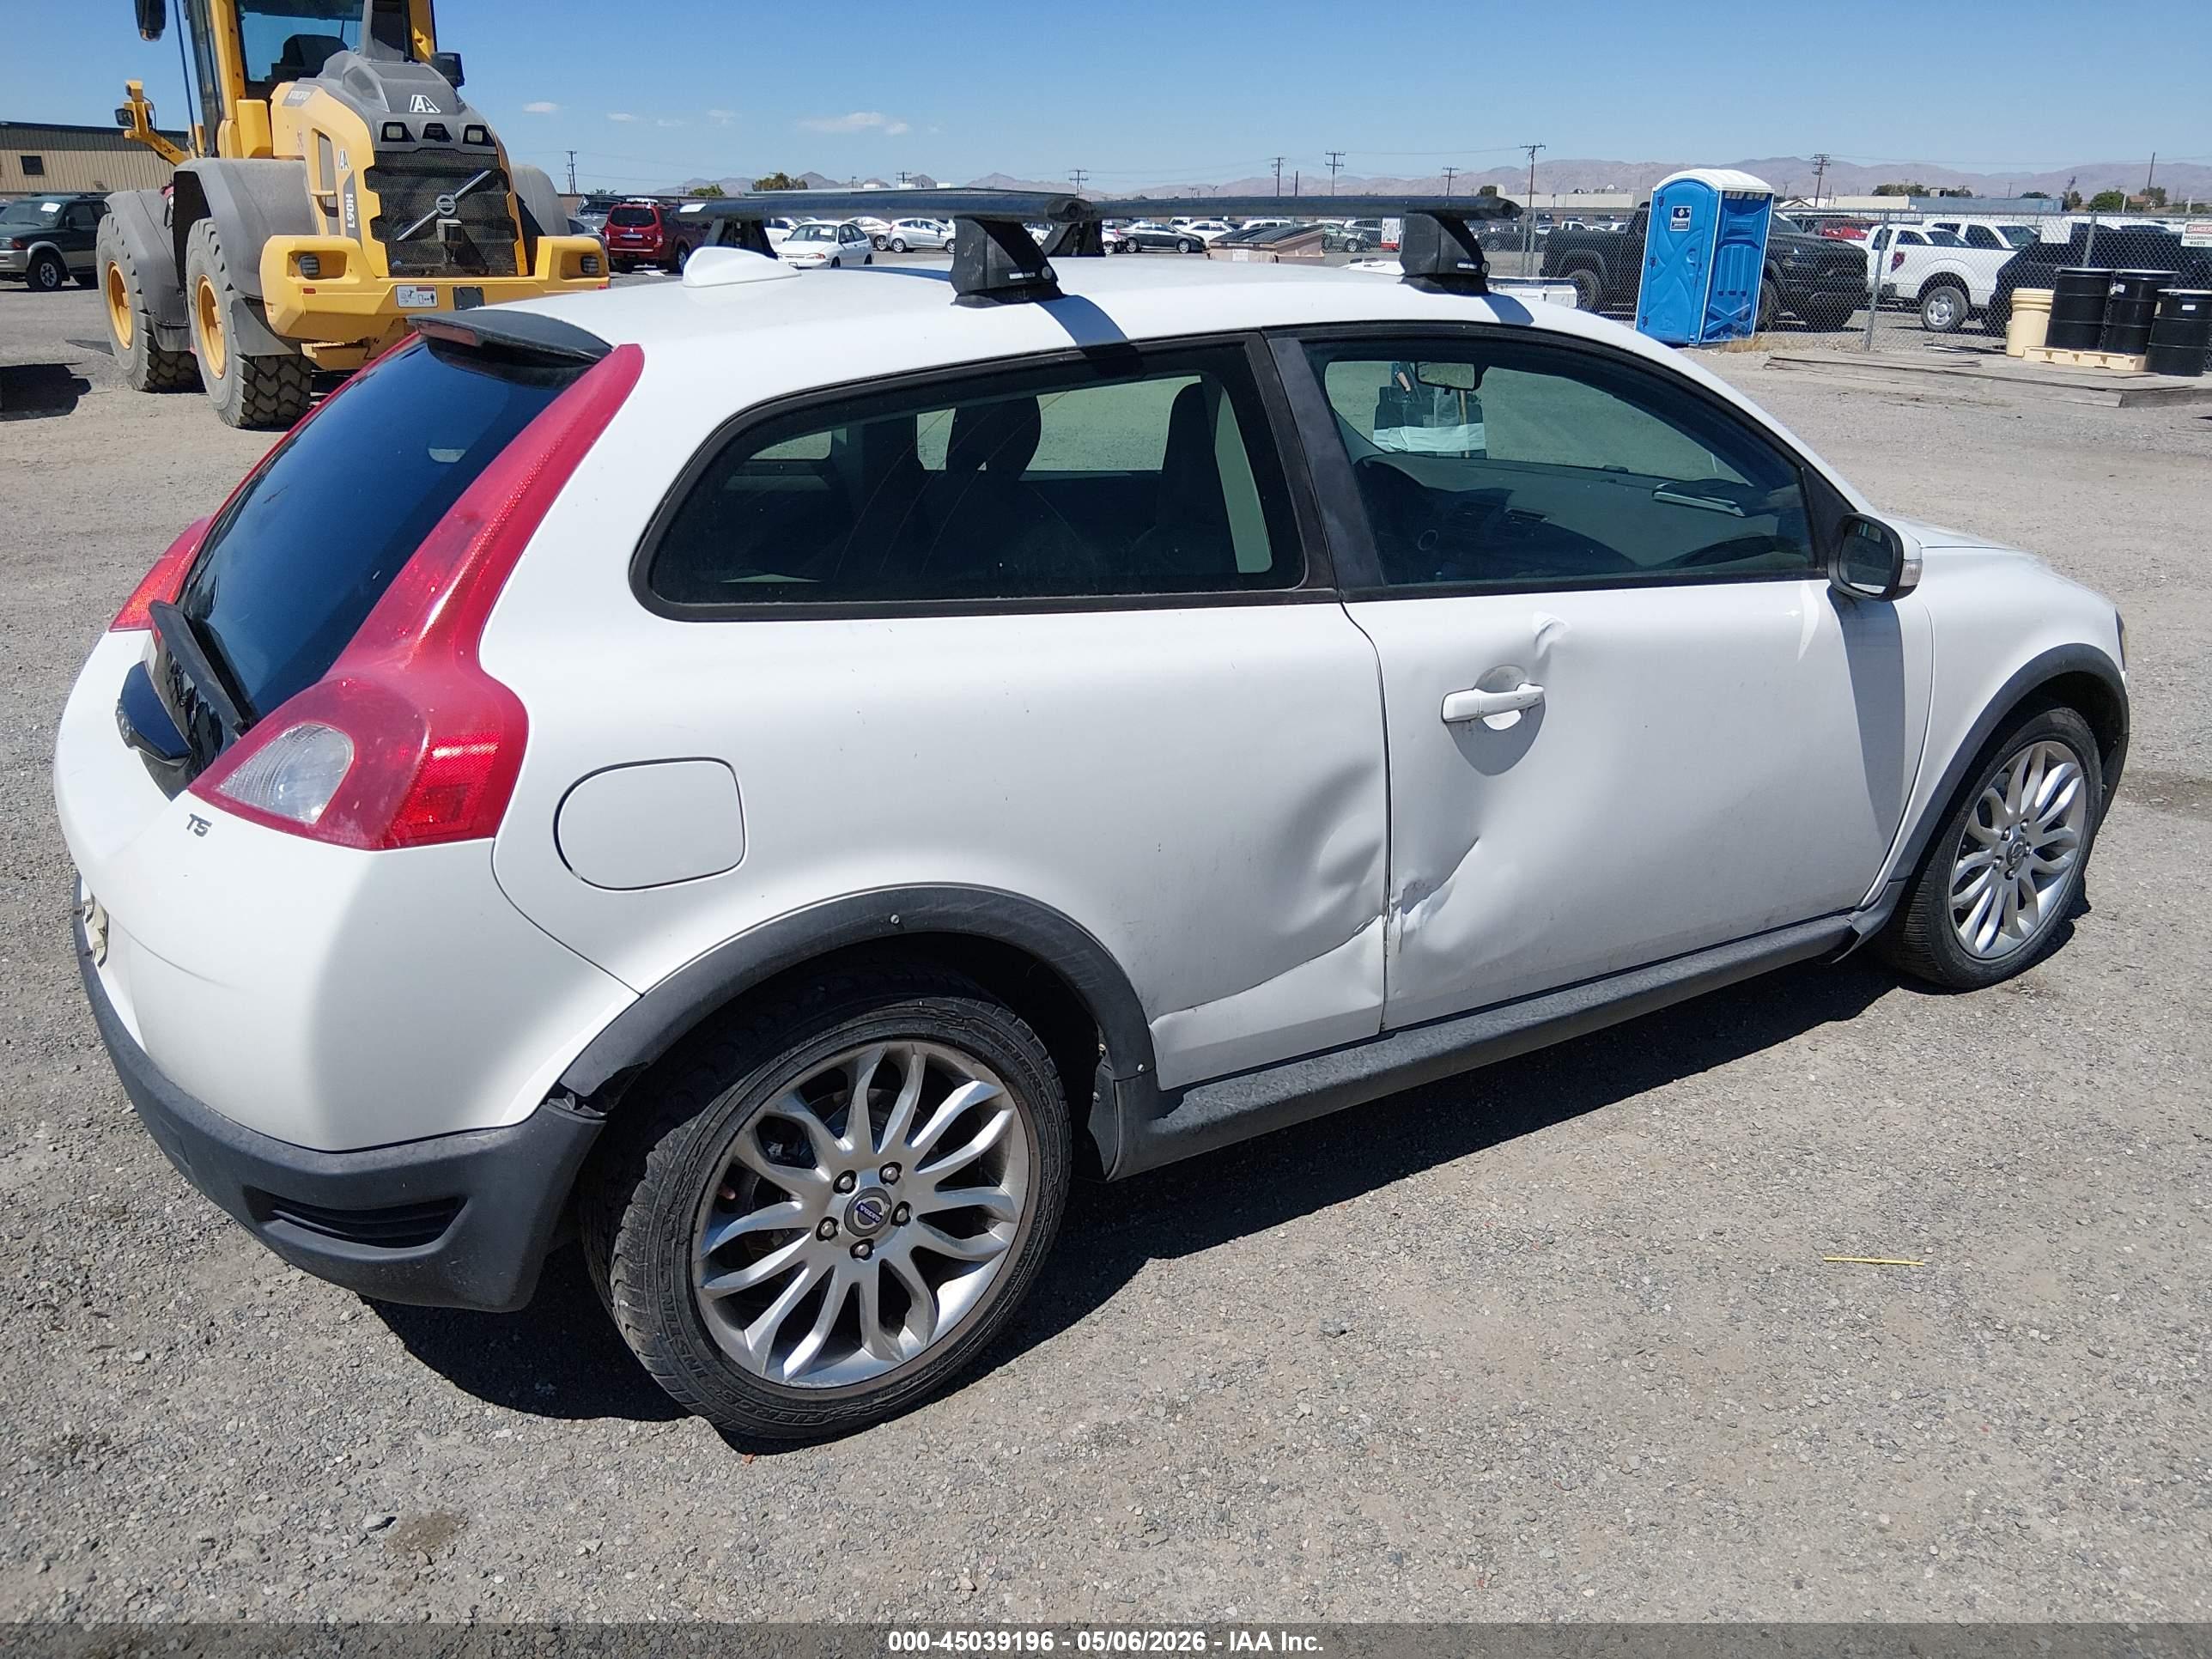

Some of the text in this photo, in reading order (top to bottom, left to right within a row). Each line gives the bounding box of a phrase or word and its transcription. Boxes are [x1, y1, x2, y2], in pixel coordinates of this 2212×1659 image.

[346, 193, 356, 228] L90H
[186, 813, 212, 837] T5
[860, 1205, 881, 1221] VOLVO
